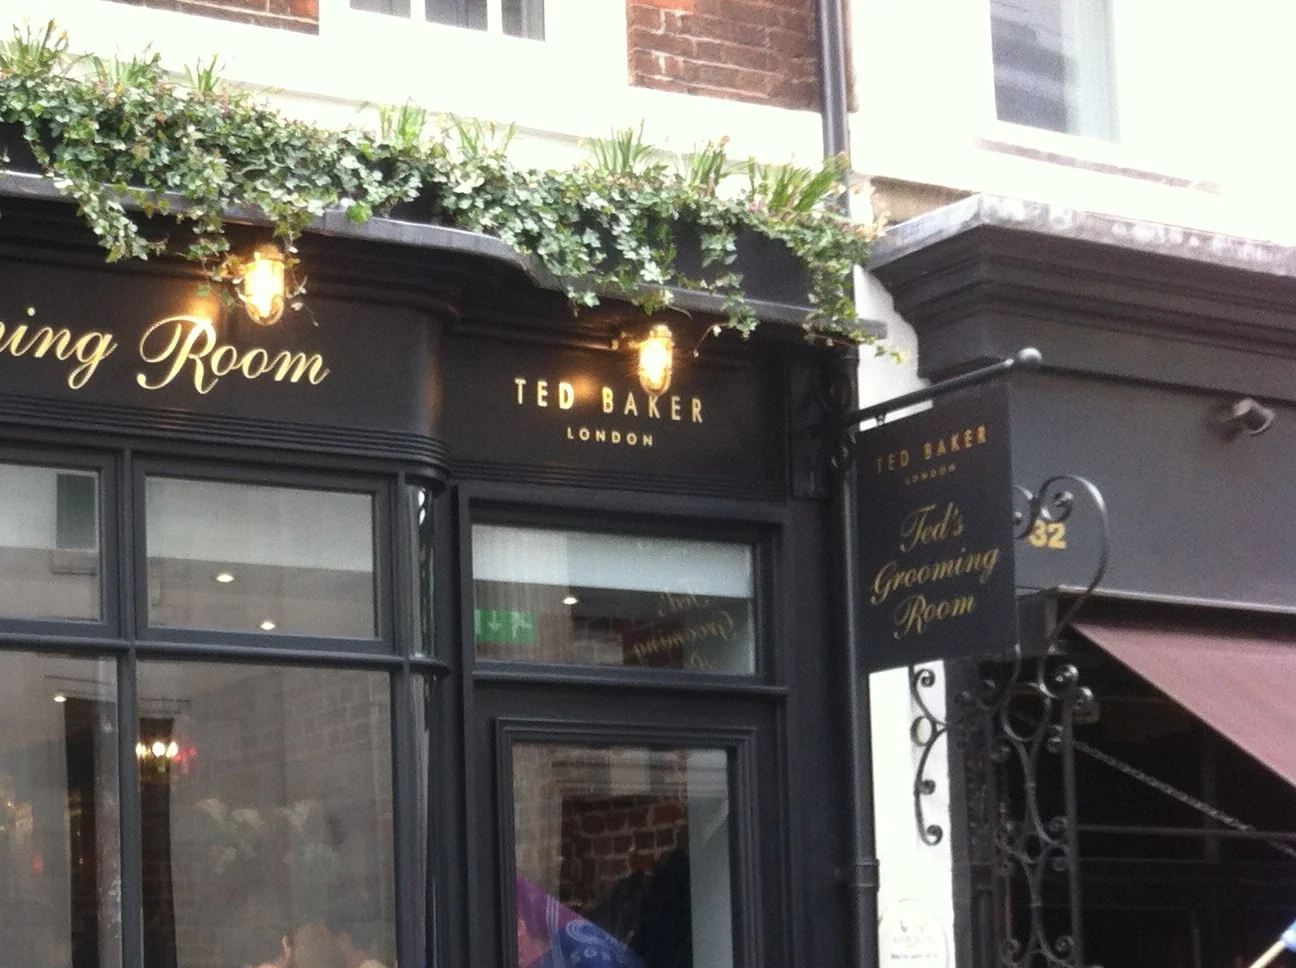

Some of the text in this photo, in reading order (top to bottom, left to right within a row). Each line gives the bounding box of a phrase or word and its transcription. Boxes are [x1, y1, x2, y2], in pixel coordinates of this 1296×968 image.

[136, 314, 331, 394] Room
[514, 378, 703, 424] TED BAKER
[567, 427, 653, 447] LONDON
[874, 424, 988, 474] TED BAKER
[905, 463, 957, 486] LONDON
[899, 501, 965, 552] Ted's
[1027, 518, 1067, 549] 32
[870, 547, 1001, 606] Grooming
[892, 593, 978, 640] Room
